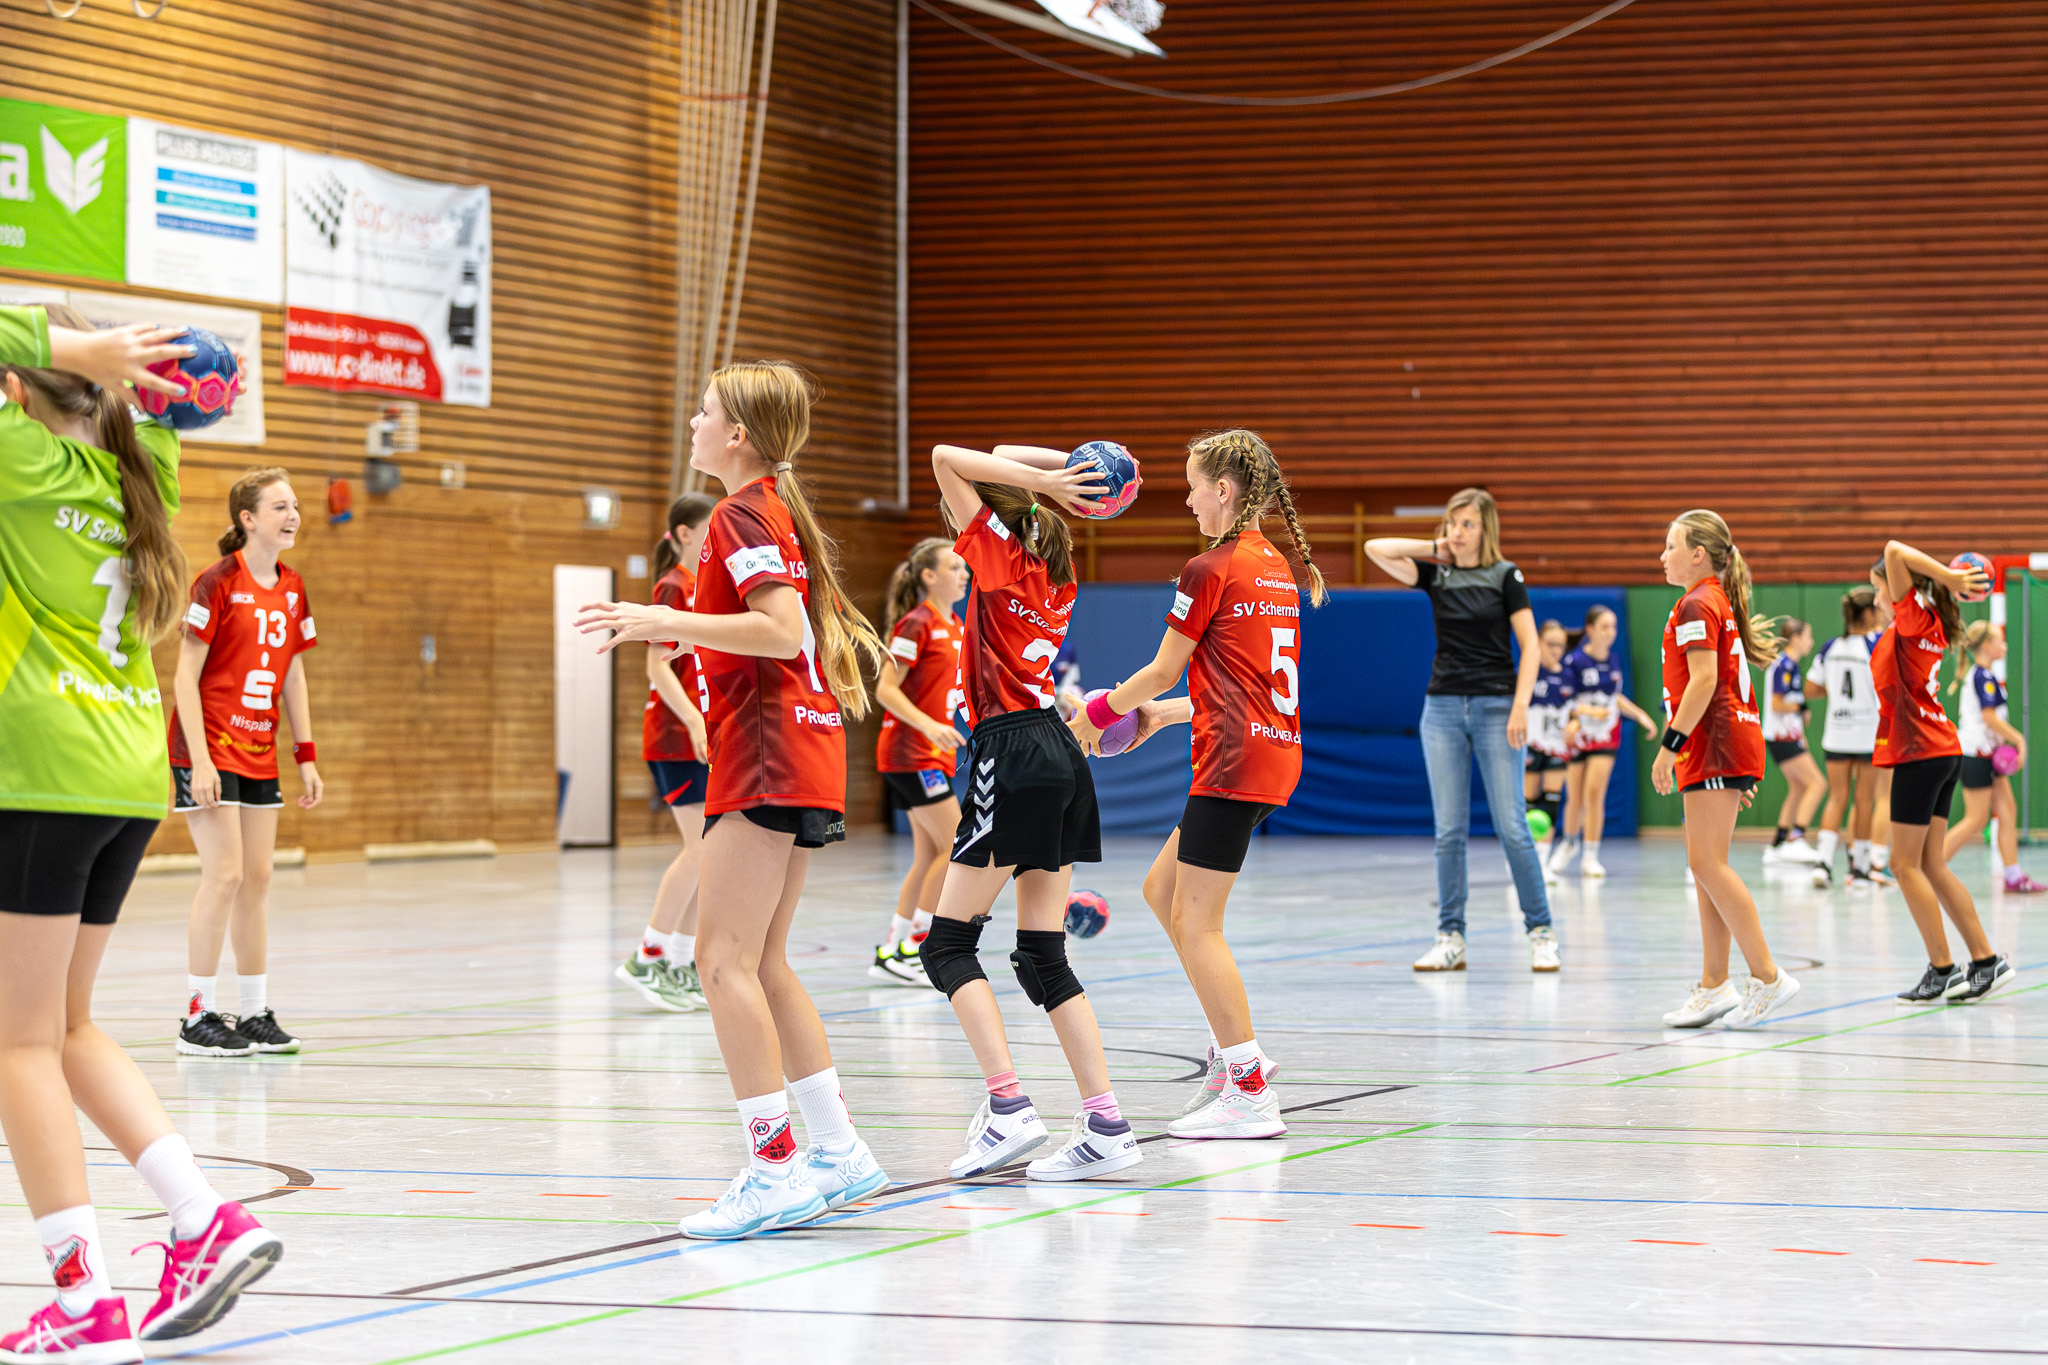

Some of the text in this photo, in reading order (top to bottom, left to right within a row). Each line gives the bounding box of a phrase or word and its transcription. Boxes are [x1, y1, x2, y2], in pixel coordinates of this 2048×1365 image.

[54, 506, 90, 534] SV
[1008, 599, 1031, 618] SV
[1233, 601, 1256, 617] SV
[254, 608, 287, 648] 13
[1270, 627, 1299, 716] 5
[1841, 669, 1854, 699] 4
